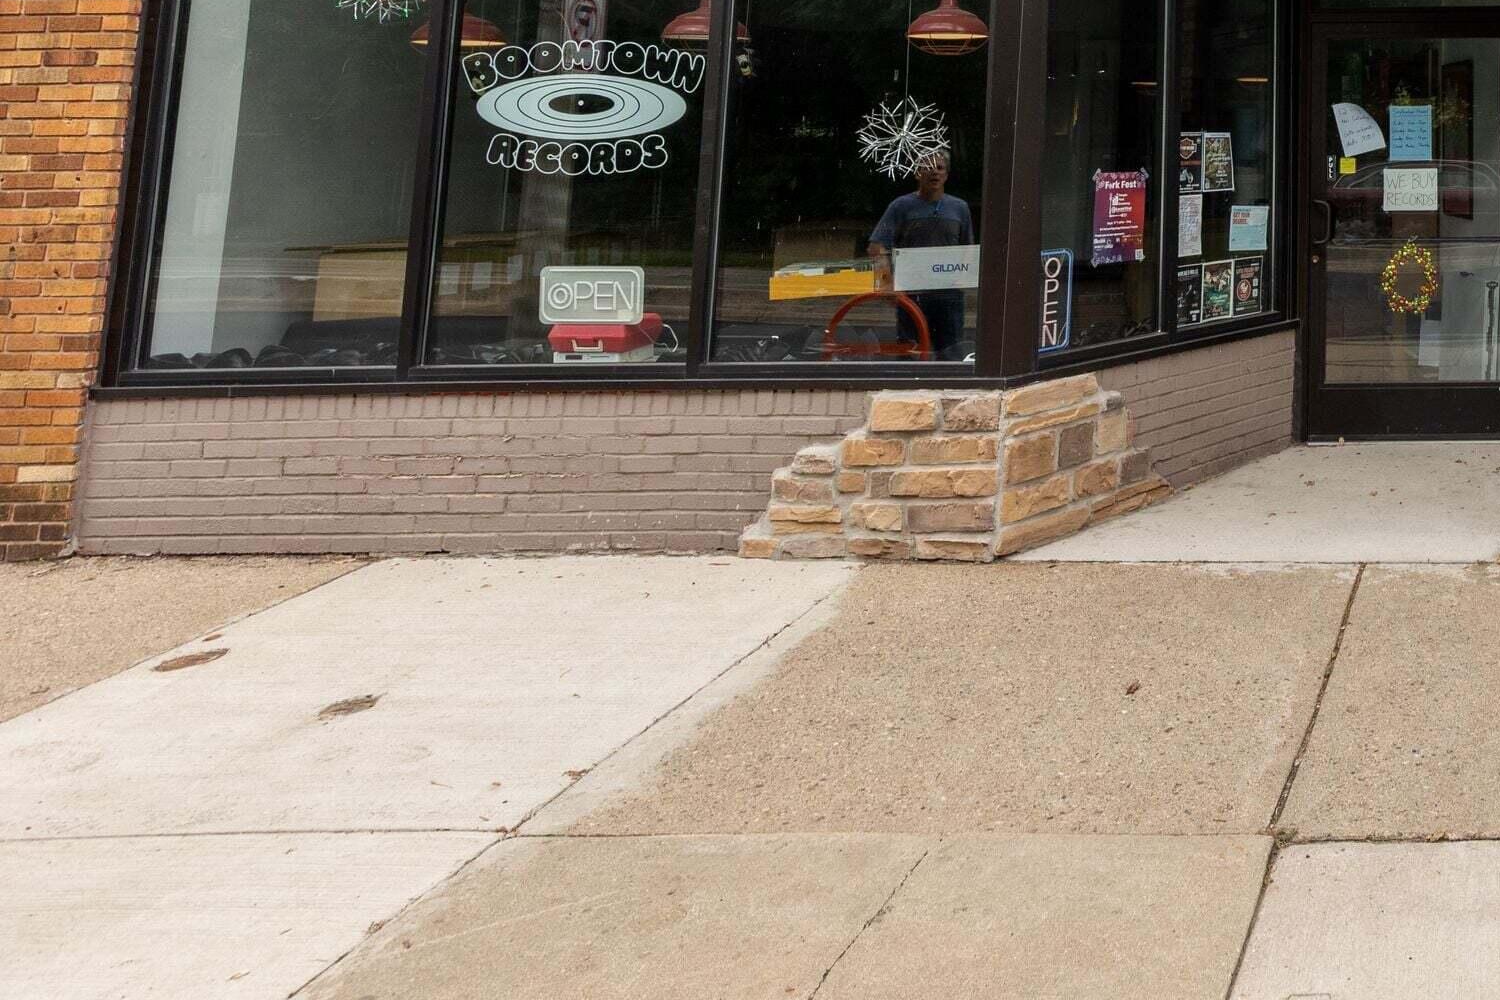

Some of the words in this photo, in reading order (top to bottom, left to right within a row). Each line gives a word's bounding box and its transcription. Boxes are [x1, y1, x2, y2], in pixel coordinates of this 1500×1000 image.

[462, 39, 706, 94] BOOMTOWN
[486, 133, 669, 176] RECORDS
[1386, 173, 1409, 189] WE
[1411, 171, 1437, 190] BUY
[932, 263, 969, 273] GILDAN
[547, 281, 635, 311] OPEN
[1041, 257, 1061, 348] OPEN
